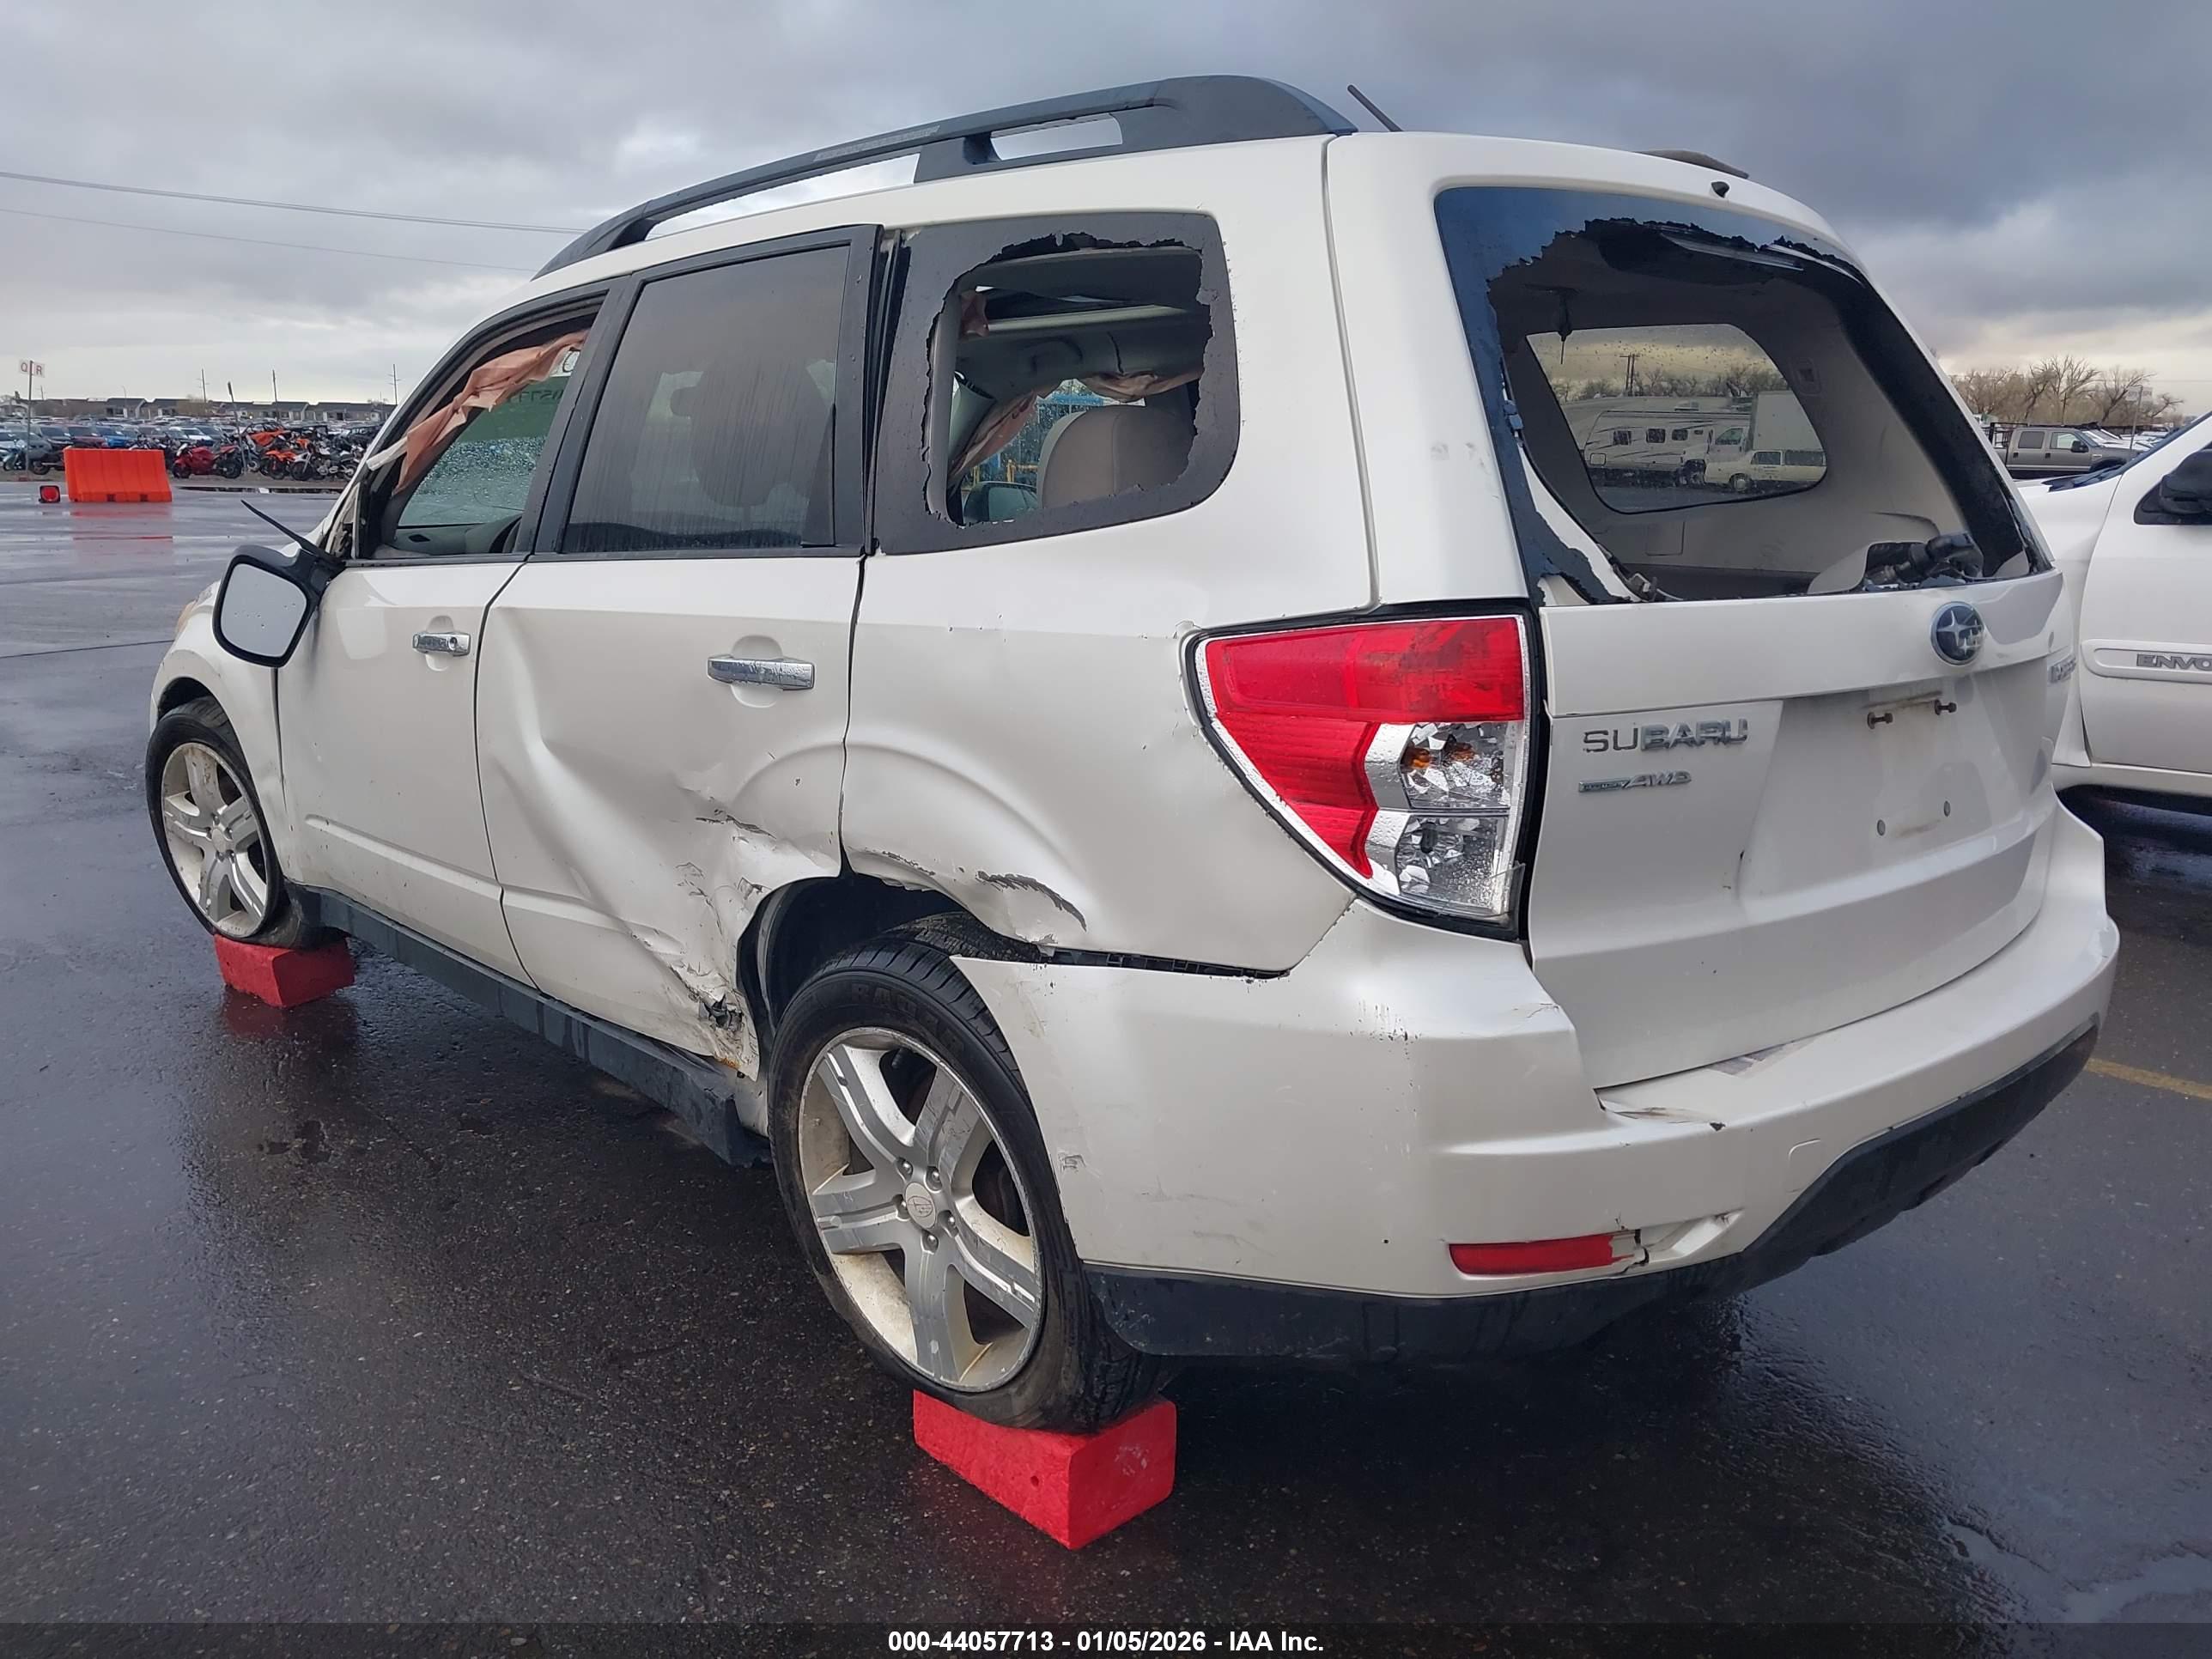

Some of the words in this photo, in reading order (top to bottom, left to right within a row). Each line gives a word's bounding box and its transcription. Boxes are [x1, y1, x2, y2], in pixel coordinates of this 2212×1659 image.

[36, 364, 42, 375] R
[1583, 718, 1749, 753] SUBARU
[1625, 771, 1692, 789] AWD
